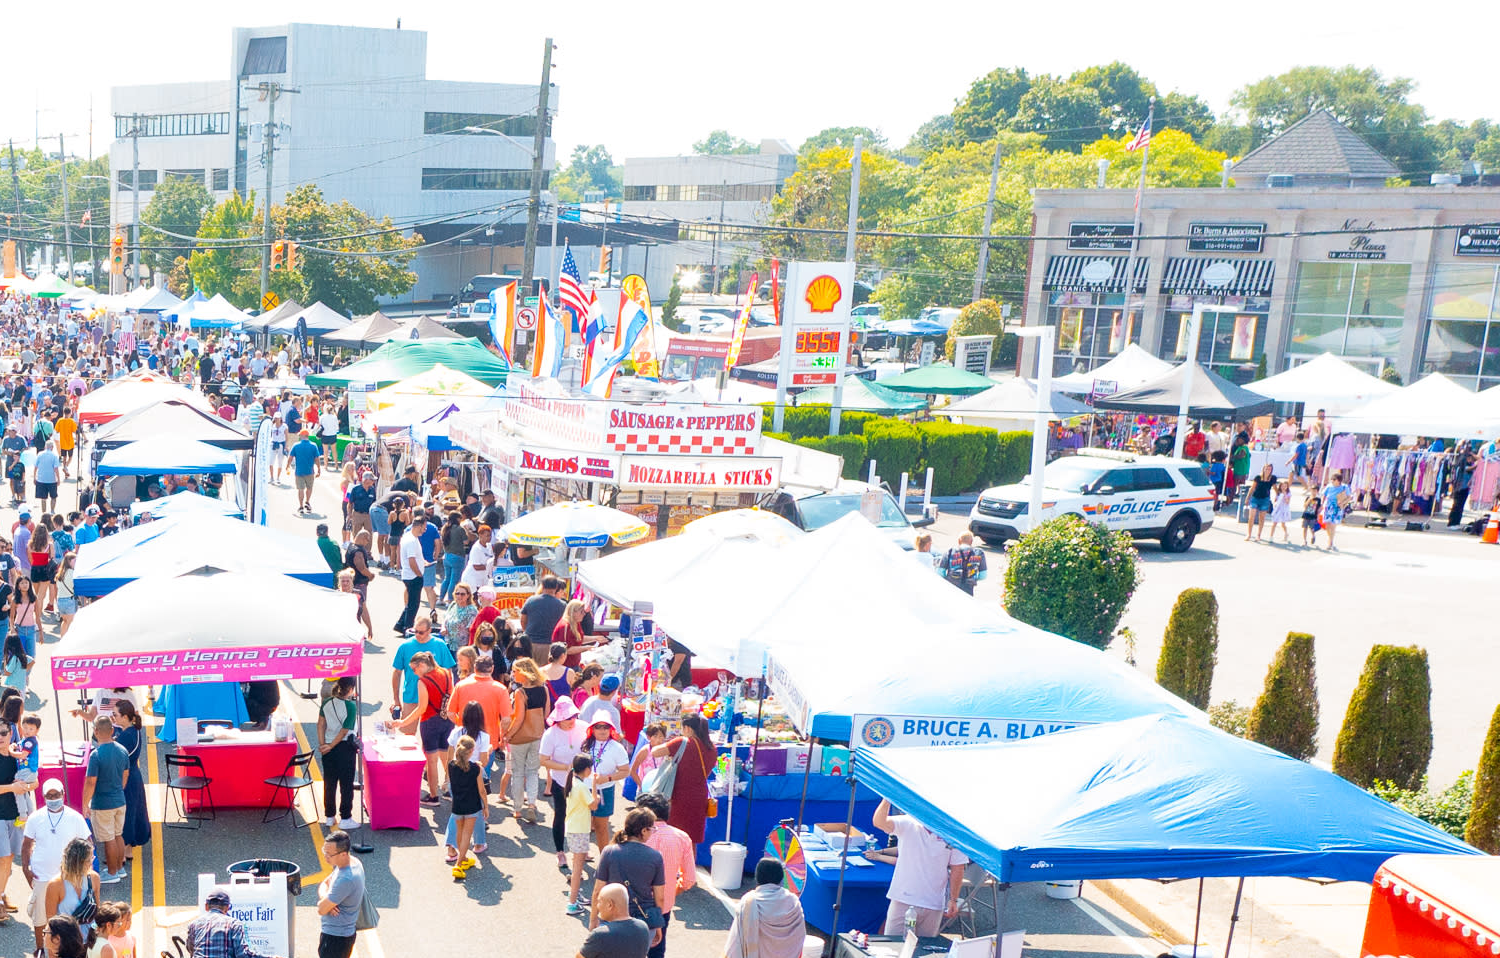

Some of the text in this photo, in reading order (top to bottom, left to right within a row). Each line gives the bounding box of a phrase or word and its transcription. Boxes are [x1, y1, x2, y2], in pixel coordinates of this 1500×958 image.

[1051, 285, 1137, 295] ORGANIC NAIL & SA
[1169, 288, 1208, 296] ORGANIC
[1211, 289, 1230, 297] NAIL
[1233, 289, 1241, 297] &
[609, 408, 756, 432] SAUSAGE & PEPPERS
[522, 450, 579, 475] NACHOS
[586, 457, 610, 468] WITH
[581, 467, 614, 479] CHEESE
[628, 464, 773, 487] MOZZARELLA STICKS
[1108, 501, 1166, 516] POLICE
[634, 640, 667, 652] OP
[53, 645, 353, 670] Temporary Henna Tattoos
[902, 720, 970, 738] BRUCE
[977, 722, 999, 739] A.
[256, 907, 276, 922] Fair
